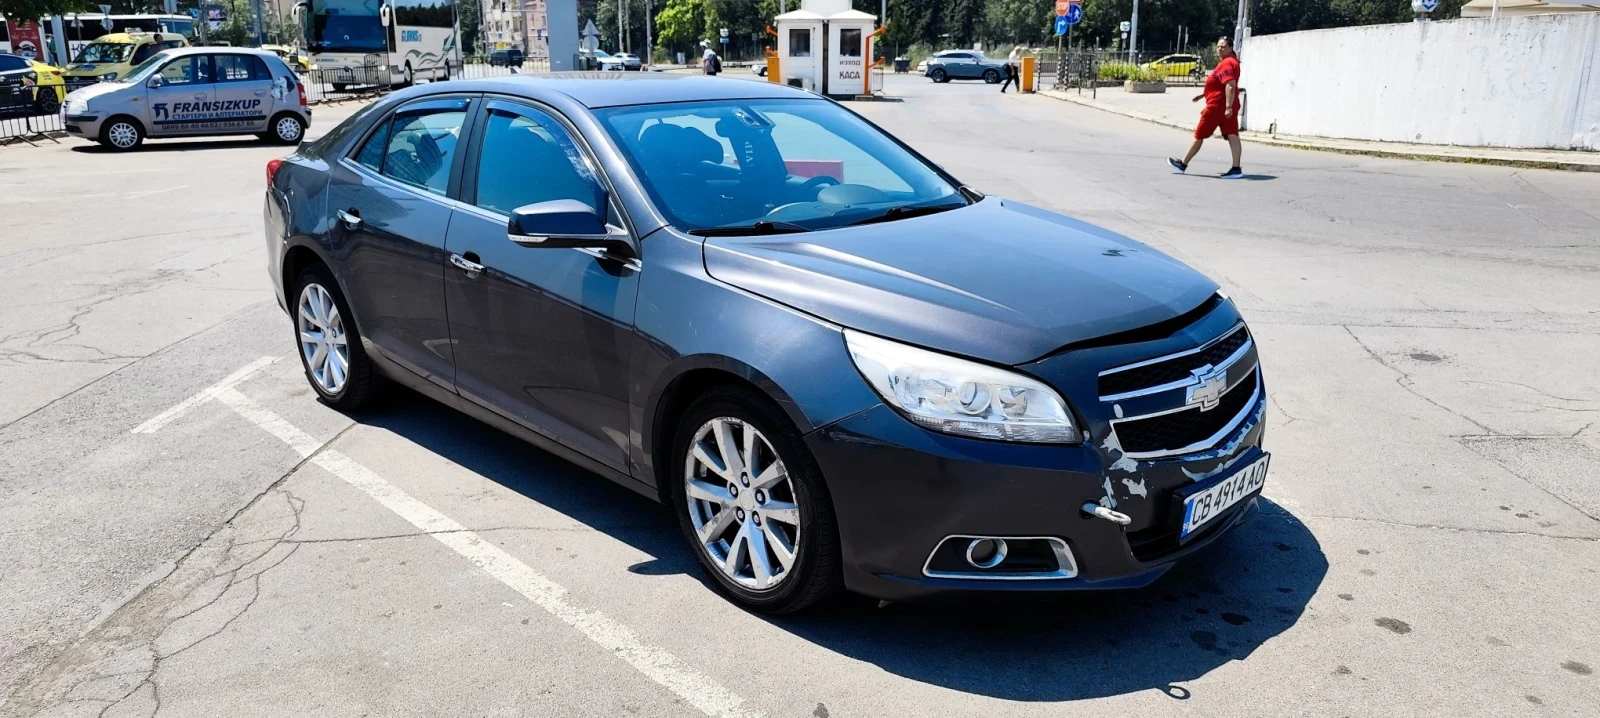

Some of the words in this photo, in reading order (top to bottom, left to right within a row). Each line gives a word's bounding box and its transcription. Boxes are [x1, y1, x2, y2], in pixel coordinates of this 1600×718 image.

[839, 71, 860, 79] КАСА
[173, 99, 261, 113] FRANSIZKUP
[214, 109, 263, 118] АЛТЕРНАТОРИ
[745, 141, 754, 163] VIP
[1193, 492, 1213, 525] CB
[1213, 472, 1247, 511] 4914
[1246, 461, 1265, 492] AO
